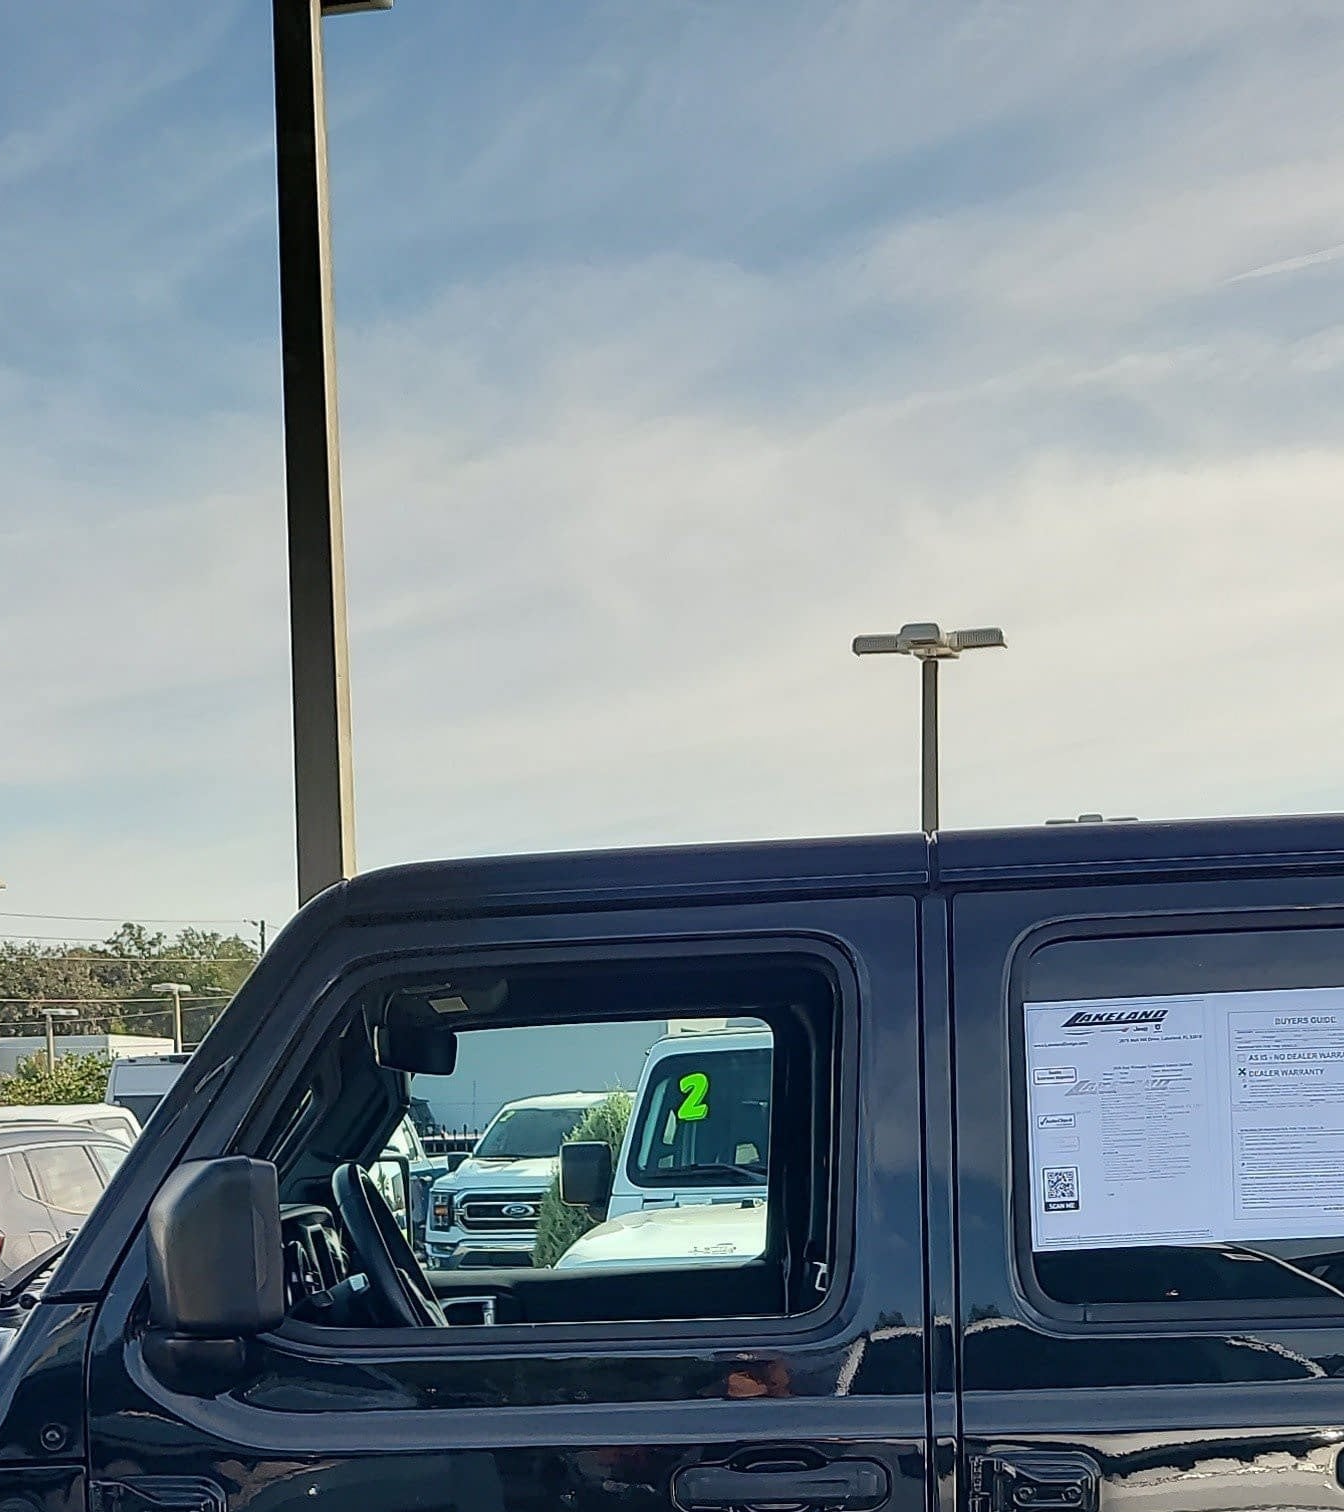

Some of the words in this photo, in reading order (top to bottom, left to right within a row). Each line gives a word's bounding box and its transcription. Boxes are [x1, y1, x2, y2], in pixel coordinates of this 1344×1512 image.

[1061, 1010, 1168, 1027] LAKELAND
[1275, 1017, 1308, 1025] BUYERS
[1310, 1016, 1336, 1024] GUIDE
[1287, 1052, 1317, 1060] DEALER
[1249, 1069, 1279, 1077] DEALER
[1281, 1068, 1324, 1076] WARRANTY
[678, 1073, 709, 1120] 2
